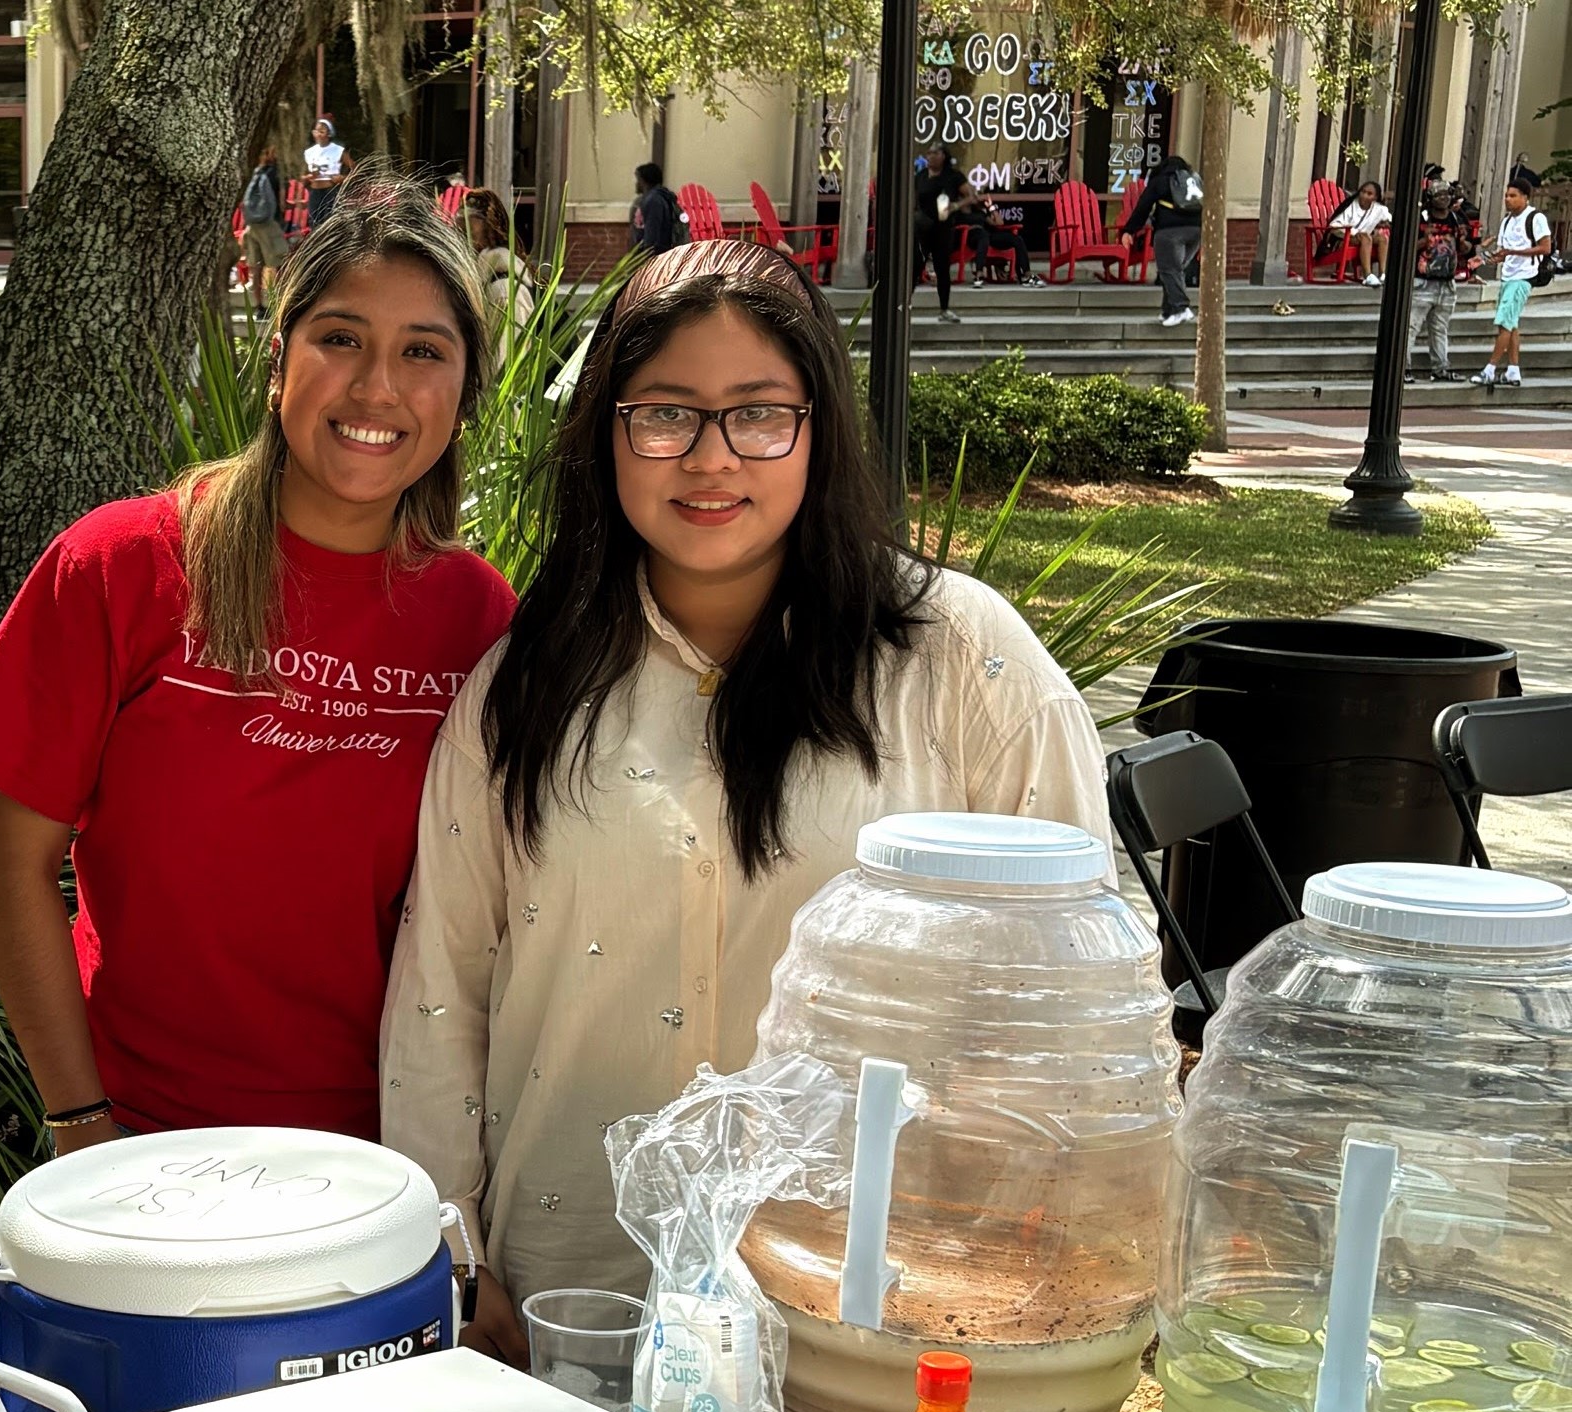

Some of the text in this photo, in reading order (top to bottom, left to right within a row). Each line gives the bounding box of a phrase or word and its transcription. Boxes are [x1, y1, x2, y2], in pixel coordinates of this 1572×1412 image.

[964, 33, 1020, 75] GO
[915, 93, 1071, 143] GREEK!
[372, 666, 472, 697] STAT
[280, 690, 368, 717] EST. 1906
[241, 713, 401, 758] University
[337, 1335, 414, 1373] IGLOO
[660, 1363, 702, 1387] Cups
